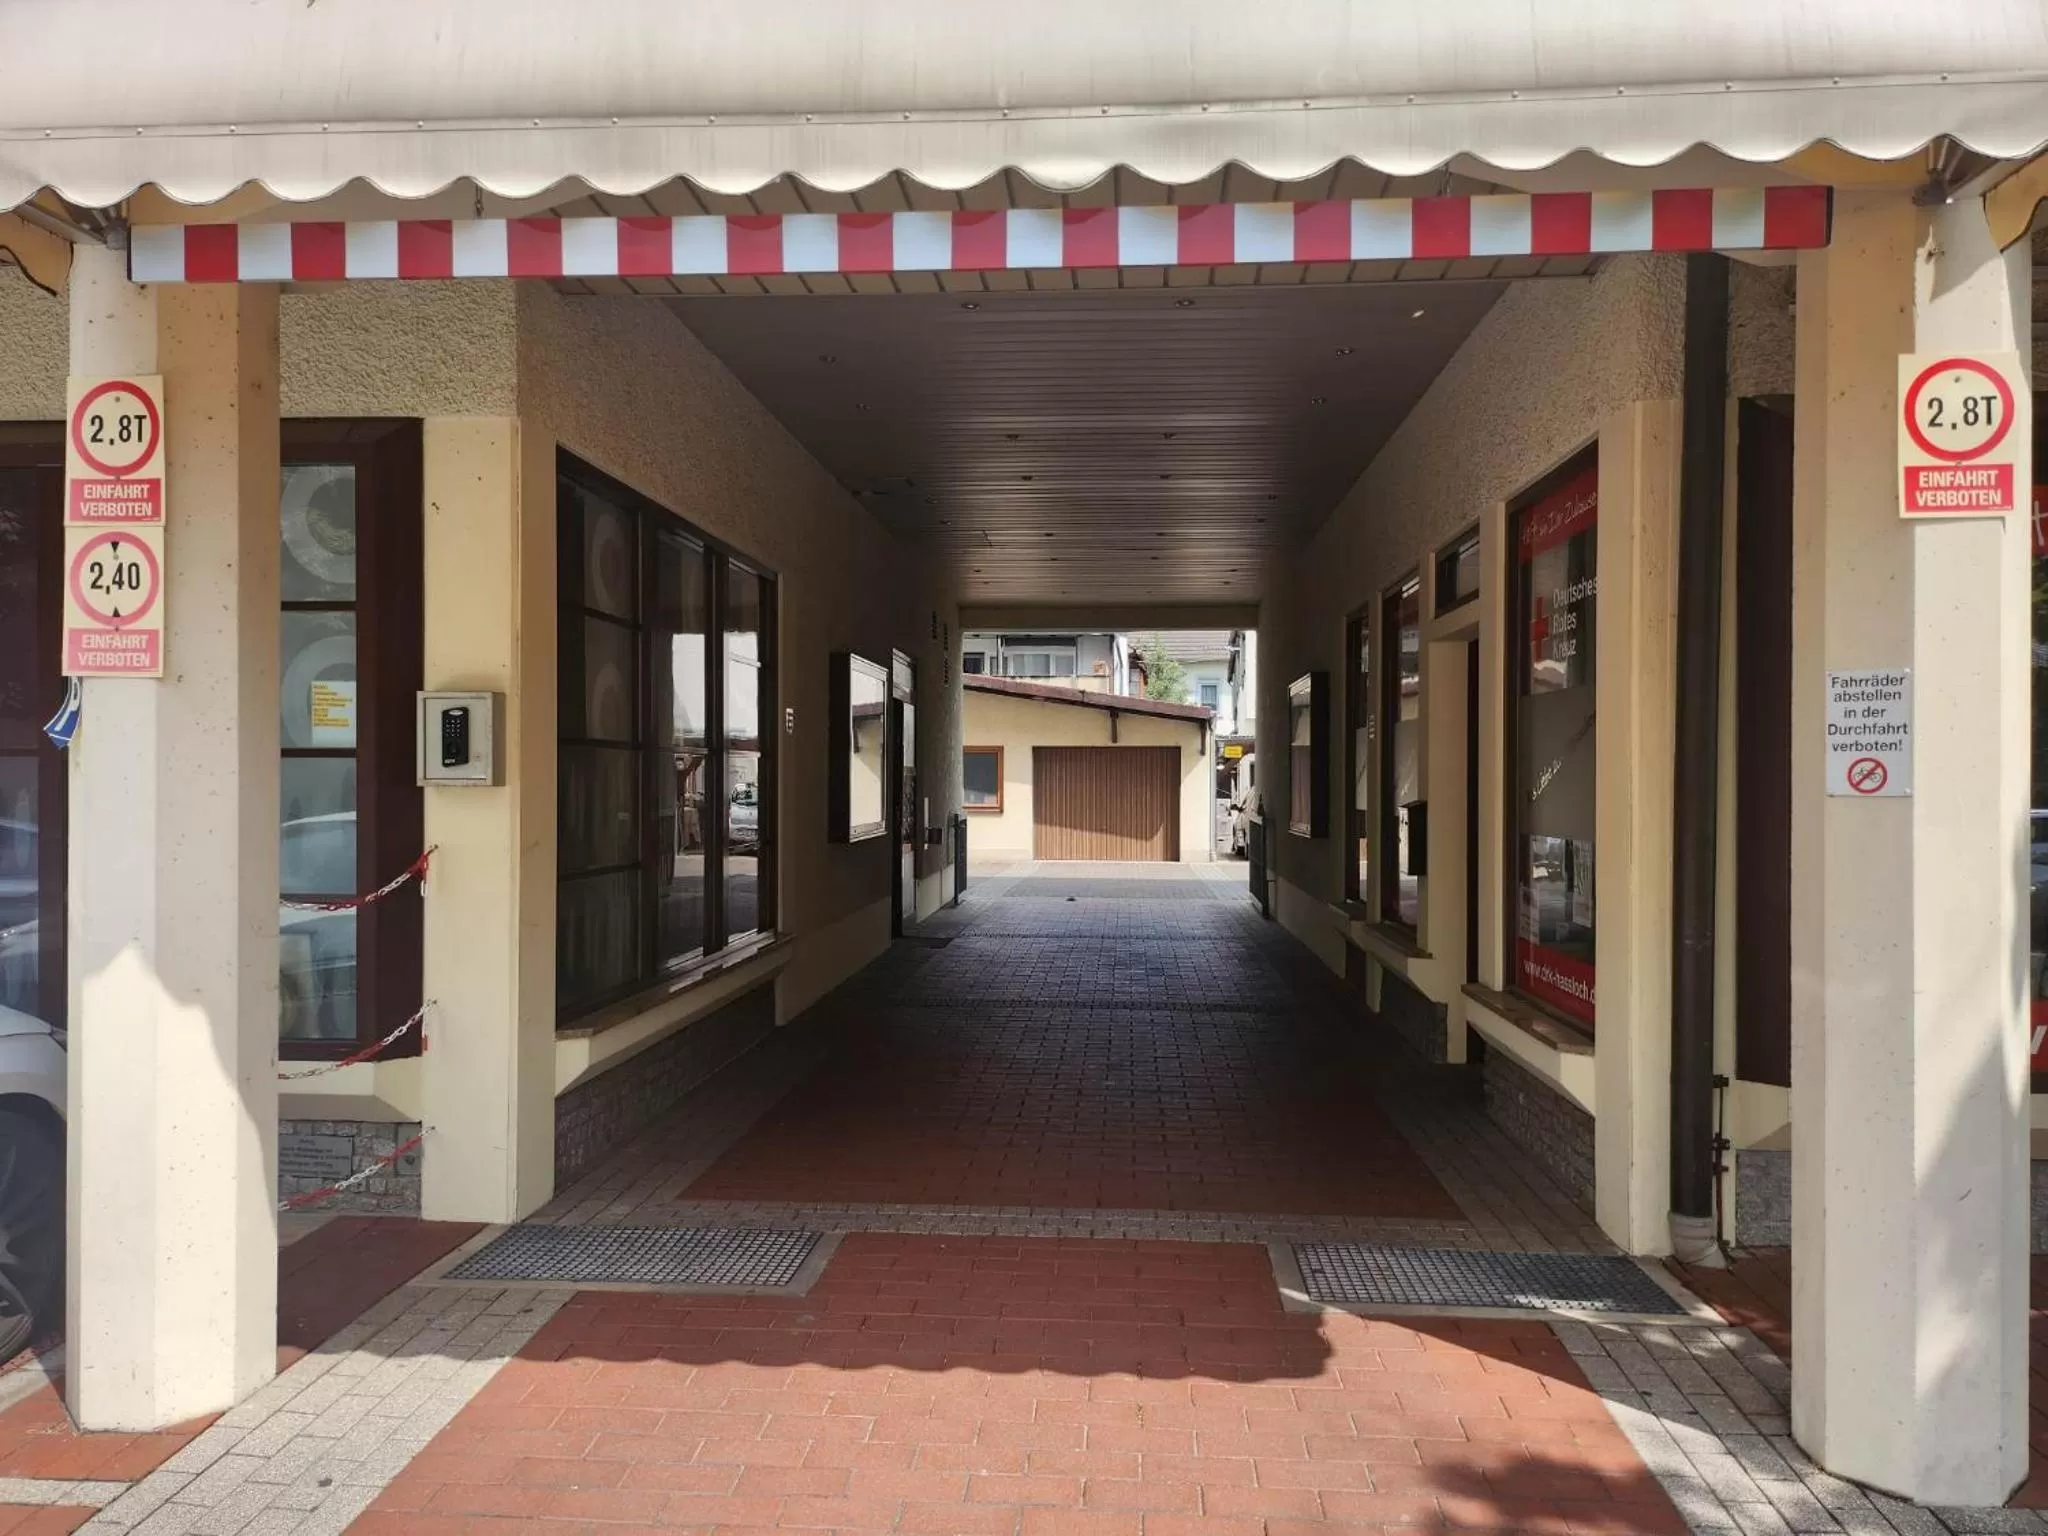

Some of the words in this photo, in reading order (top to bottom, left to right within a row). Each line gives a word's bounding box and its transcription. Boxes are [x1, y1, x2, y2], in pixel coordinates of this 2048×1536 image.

[1927, 395, 1998, 430] 2.8T
[1919, 470, 1999, 488] EINFAHRT
[83, 484, 150, 499] EINFAHRT
[1915, 488, 2002, 507] VERBOTEN
[80, 501, 152, 517] VERBOTEN
[89, 561, 141, 595] 2,40
[1552, 576, 1598, 609] Deutsches
[1552, 611, 1577, 635] Rotes
[81, 634, 149, 649] EINFAHRT
[1552, 638, 1577, 660] Kreuz
[77, 652, 150, 667] VERBOTEN
[1831, 674, 1906, 689] Fahrräder
[1833, 689, 1902, 703] abstellen
[1843, 707, 1857, 719] in
[1861, 706, 1887, 719] der
[1827, 723, 1909, 736] Durchfahrt
[1831, 740, 1903, 753] verboten!
